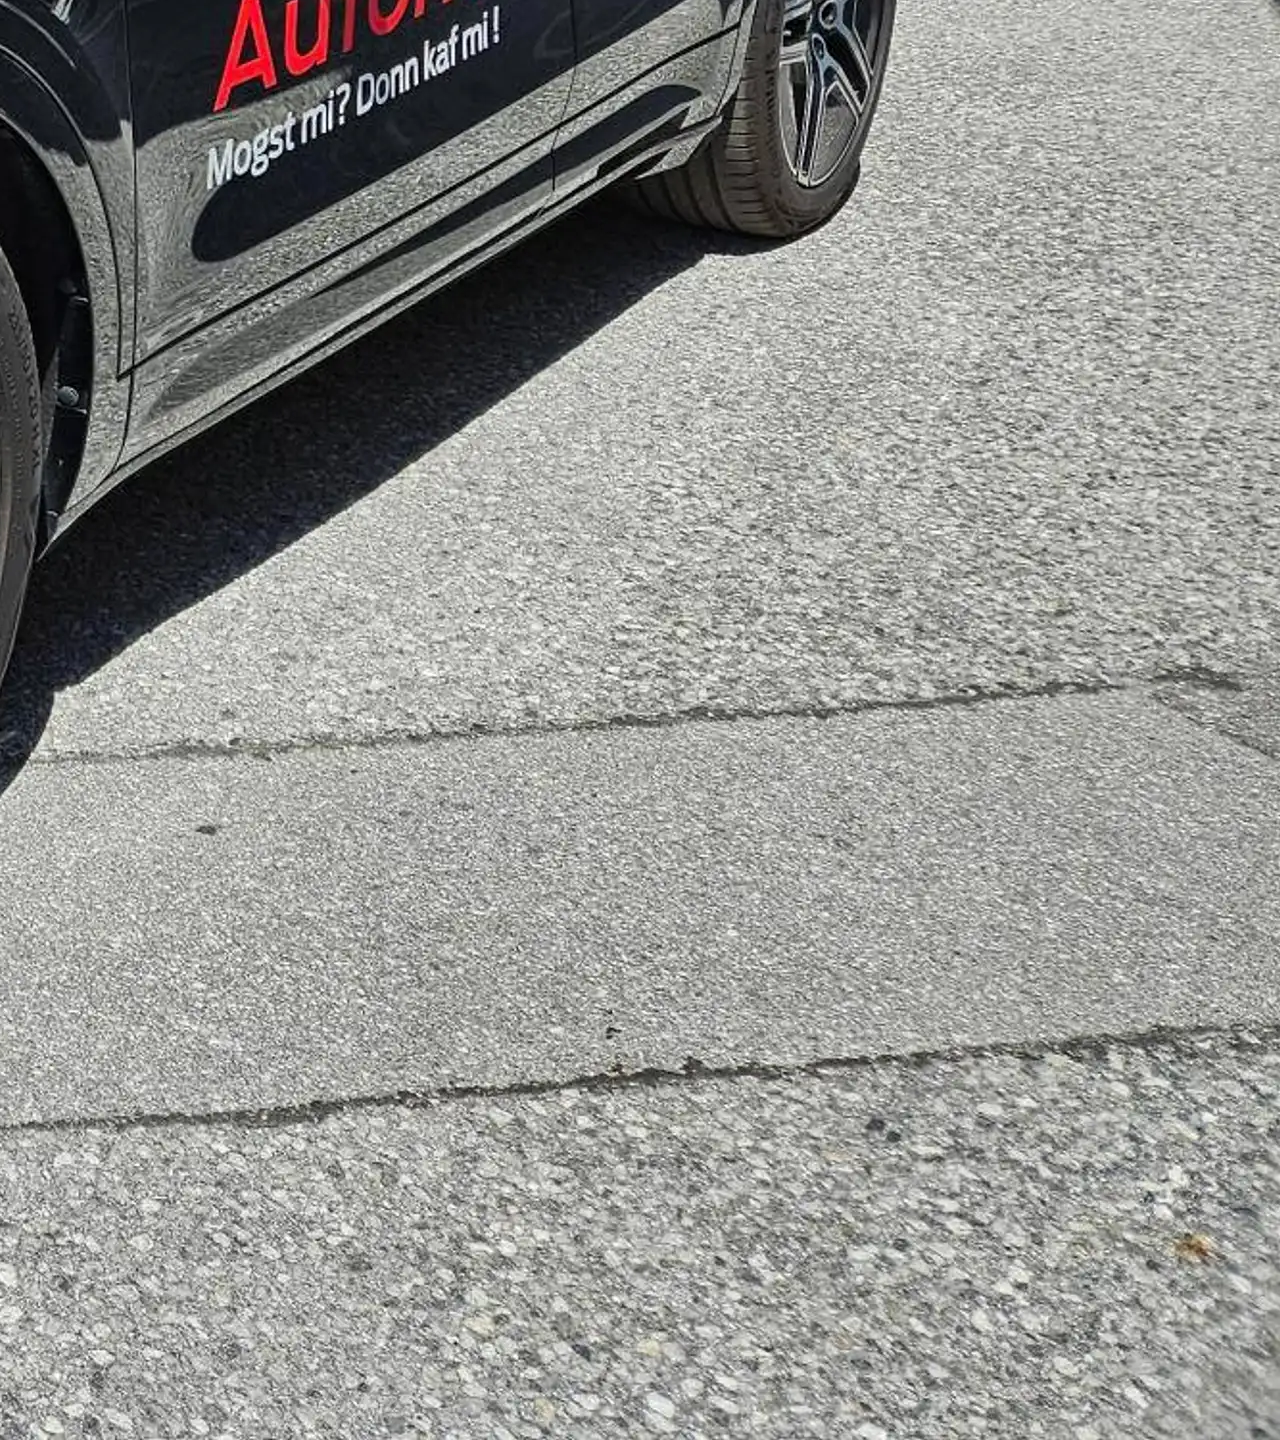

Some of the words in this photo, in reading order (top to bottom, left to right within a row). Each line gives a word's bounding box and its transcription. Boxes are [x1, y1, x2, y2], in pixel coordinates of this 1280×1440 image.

[206, 114, 295, 190] Mogst
[300, 82, 351, 145] mi?
[355, 56, 419, 117] Donn
[423, 25, 458, 83] kaf
